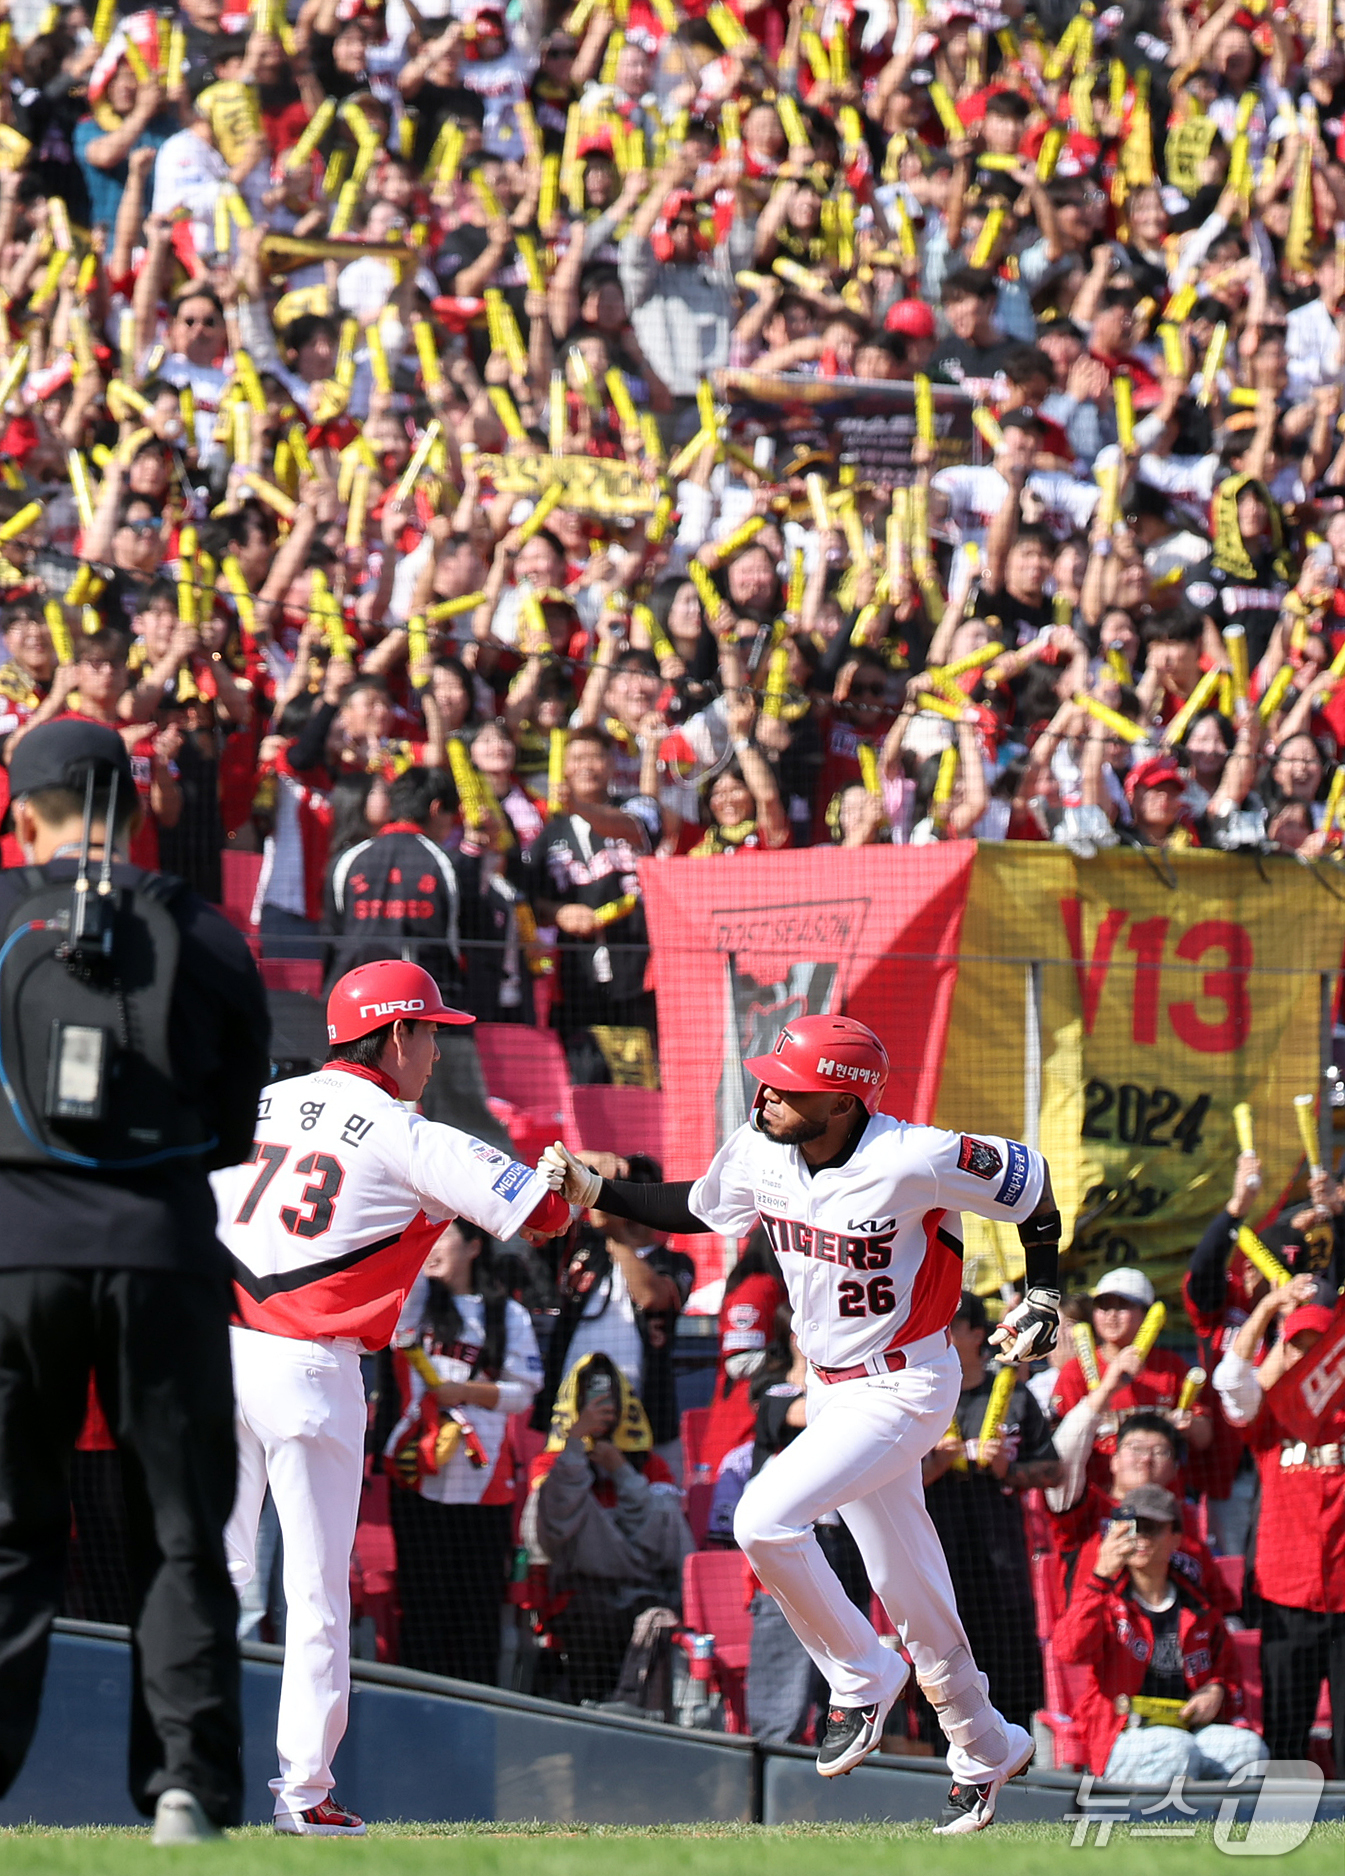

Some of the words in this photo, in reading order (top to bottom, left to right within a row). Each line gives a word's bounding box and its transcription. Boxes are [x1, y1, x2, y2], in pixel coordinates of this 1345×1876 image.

[1060, 898, 1254, 1053] V13
[360, 999, 425, 1018] NIRO
[835, 1062, 880, 1085] 현대해상
[1081, 1077, 1212, 1154] 2024
[233, 1140, 346, 1240] 73
[1003, 1150, 1025, 1203] 현대차증권
[758, 1209, 900, 1271] TIGERS
[837, 1275, 897, 1318] 26
